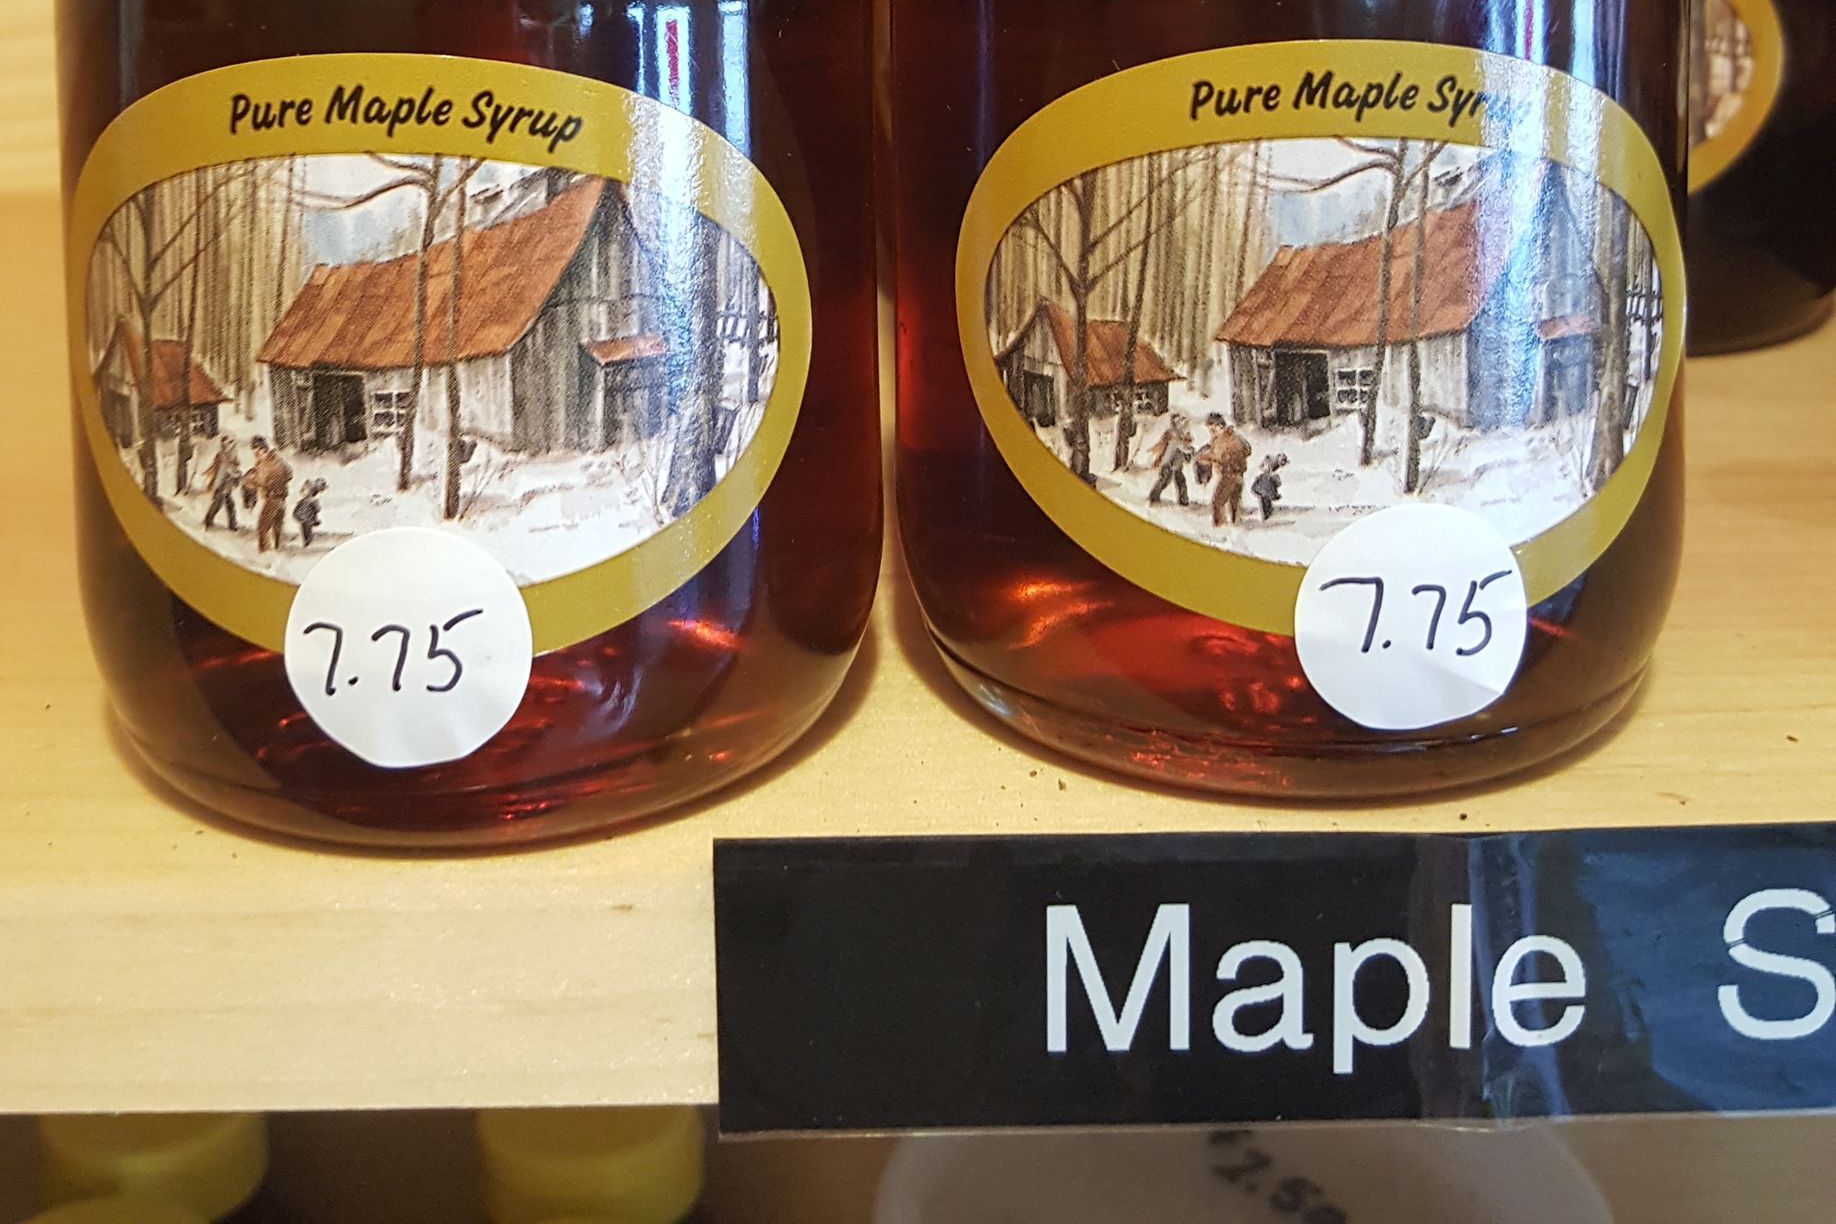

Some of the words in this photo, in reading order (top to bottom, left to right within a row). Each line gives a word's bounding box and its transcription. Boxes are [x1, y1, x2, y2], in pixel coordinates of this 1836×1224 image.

[229, 93, 313, 135] Pure
[324, 83, 454, 138] Maple
[462, 89, 585, 154] Syrup
[1189, 80, 1281, 121] Pure
[1292, 70, 1420, 123] Maple
[1426, 74, 1496, 127] Syr
[304, 608, 484, 697] 7.75
[1319, 569, 1513, 657] 7.75
[1044, 901, 1588, 1075] Maple
